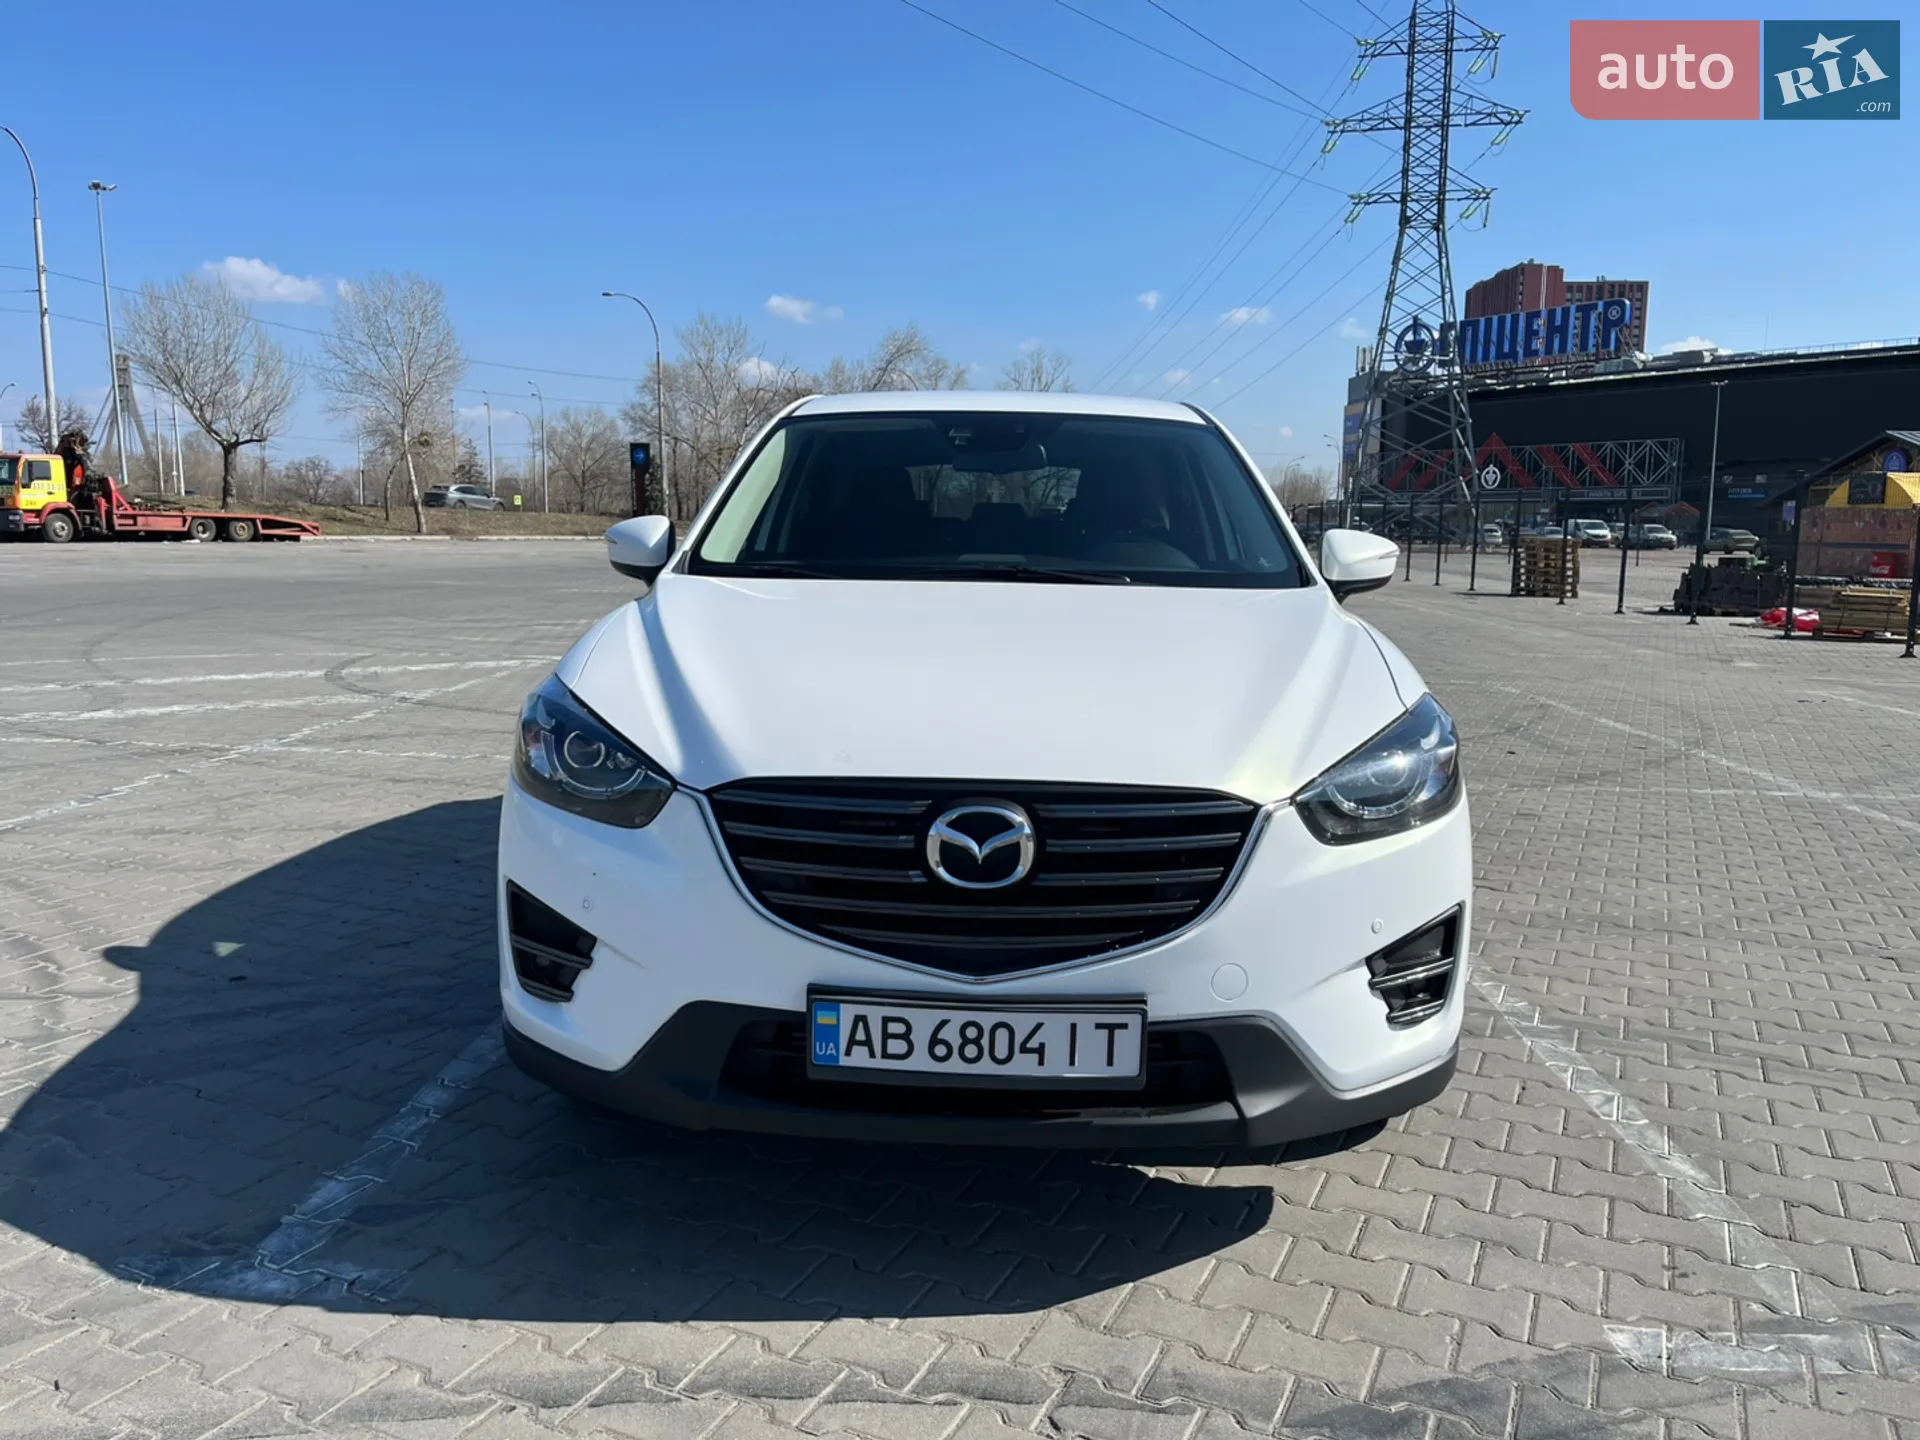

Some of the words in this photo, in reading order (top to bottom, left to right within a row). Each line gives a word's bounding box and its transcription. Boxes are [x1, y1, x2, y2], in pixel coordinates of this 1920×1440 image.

[816, 1041, 837, 1057] UA
[844, 1014, 915, 1061] AB
[927, 1018, 1046, 1067] 6804
[1069, 1022, 1129, 1067] IT
